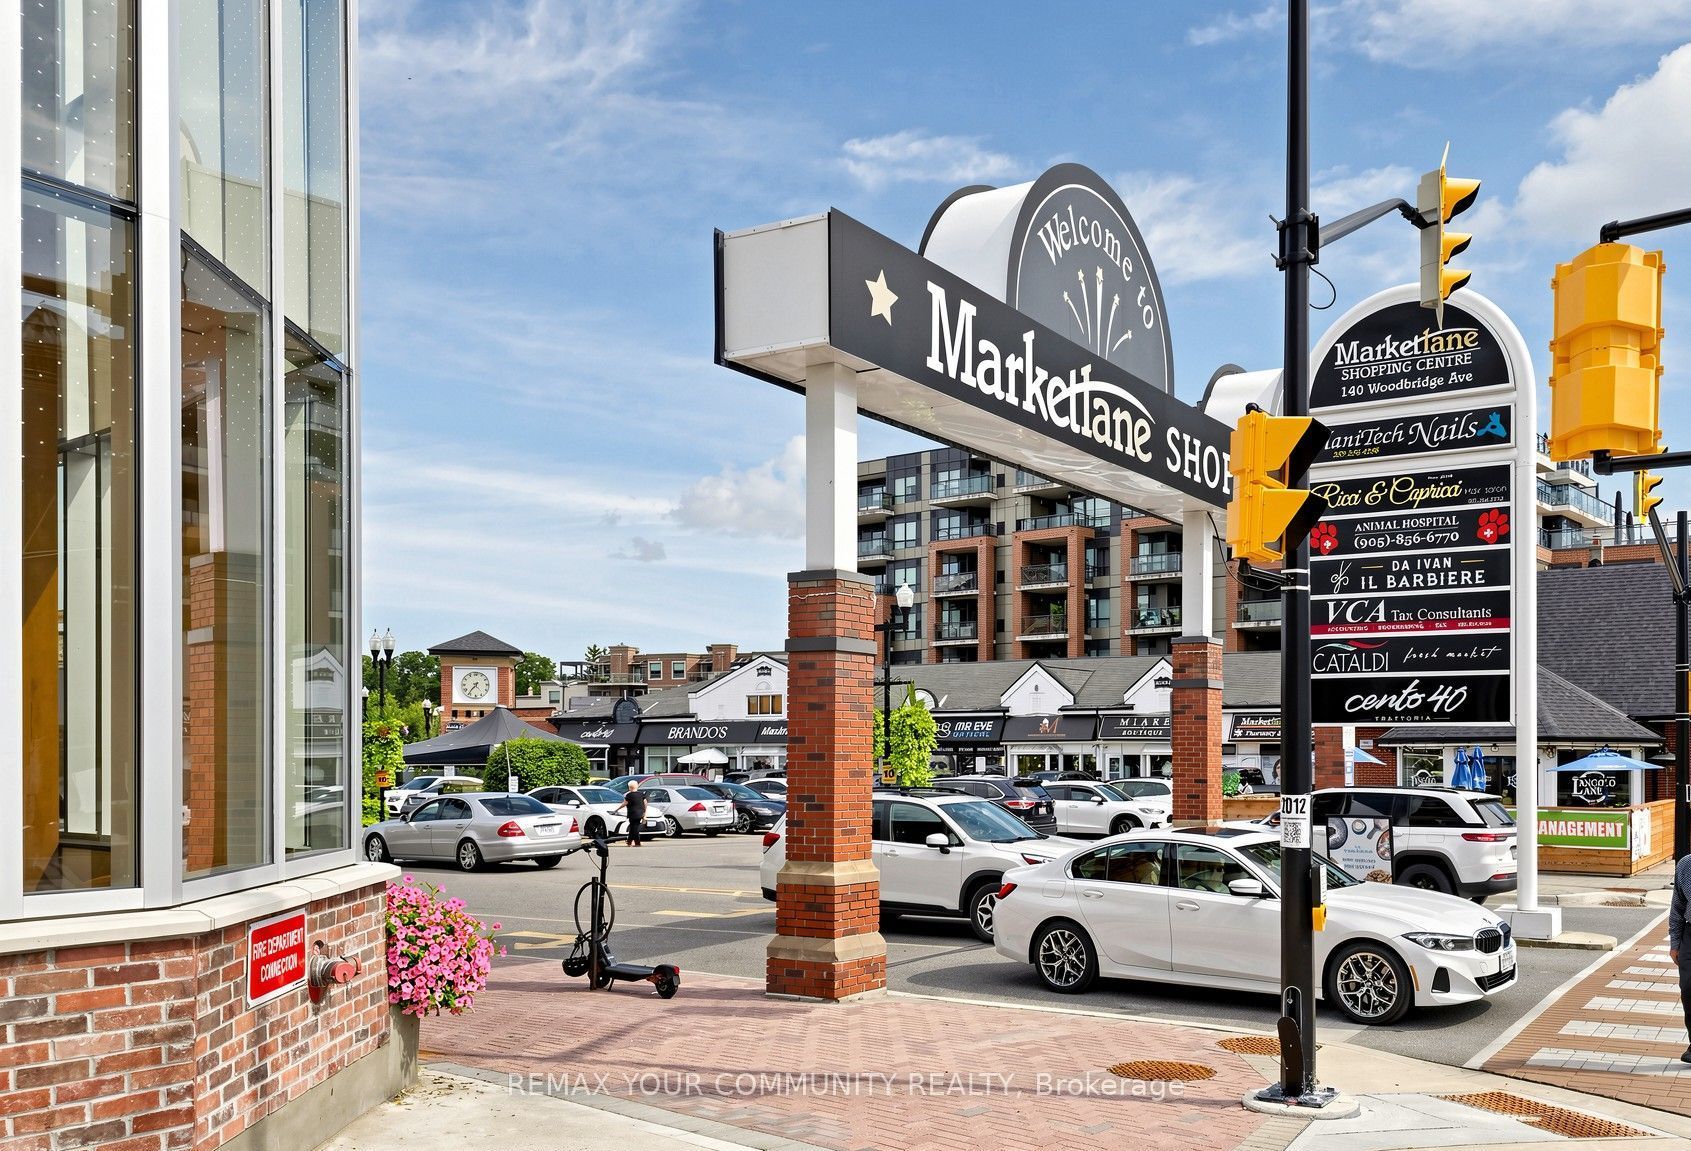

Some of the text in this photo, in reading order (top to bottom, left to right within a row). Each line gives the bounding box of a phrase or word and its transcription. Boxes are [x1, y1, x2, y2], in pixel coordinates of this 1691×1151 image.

[1037, 204, 1155, 330] Welcome to
[1334, 327, 1479, 367] Marketlane
[1341, 352, 1472, 381] SHOPPING CENTRE
[1341, 372, 1473, 398] 140 Woodbridge Ave
[1408, 411, 1478, 448] Nails
[1365, 481, 1388, 504] &
[1355, 515, 1459, 532] ANIMAL HOSPITAL
[1354, 530, 1459, 549] (905)-856-6770
[1392, 557, 1452, 571] DA IVAN
[1361, 570, 1485, 590] IL BARBIERE
[1327, 600, 1492, 624] VCA Tax Consultants
[1313, 651, 1389, 672] CATALDI
[1344, 678, 1468, 713] cento 40
[667, 726, 729, 740] BRANDO'S
[954, 720, 994, 731] MR EYE
[884, 769, 895, 778] 10
[1536, 820, 1624, 838] ANAGEMENT
[253, 928, 304, 961] FIRE DEPARTMENT
[260, 952, 298, 983] CONNECTION
